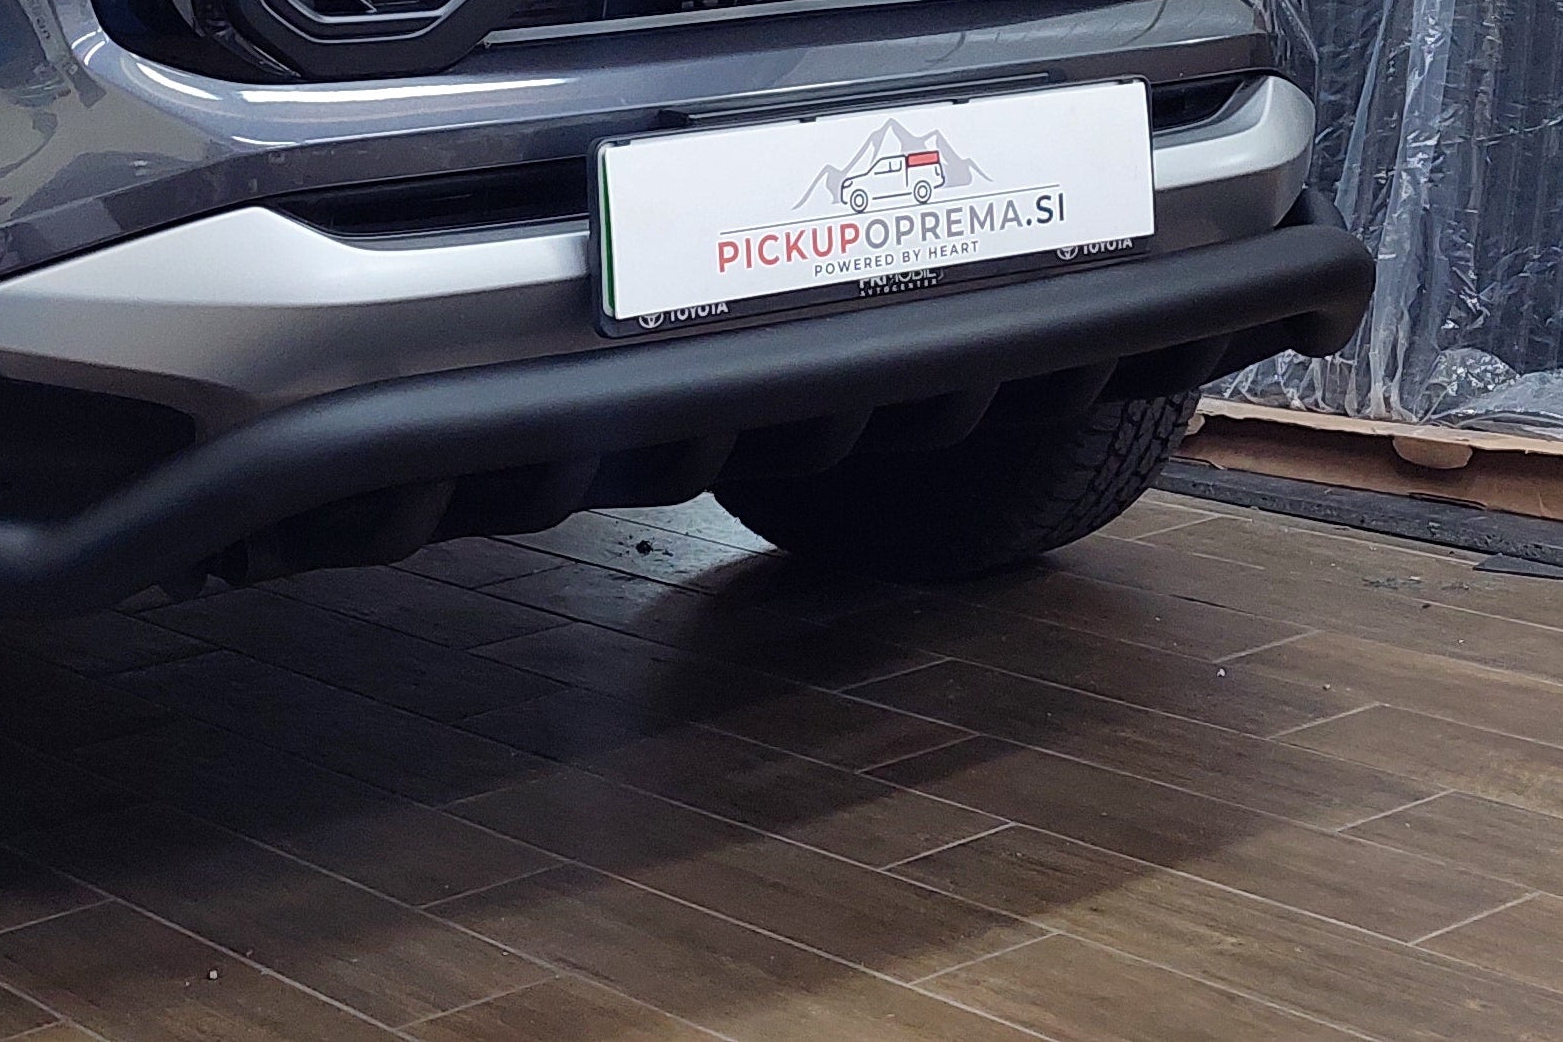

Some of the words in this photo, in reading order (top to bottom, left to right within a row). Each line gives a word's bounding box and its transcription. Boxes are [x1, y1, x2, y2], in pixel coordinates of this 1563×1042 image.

[717, 192, 1065, 273] PICKUPOPREMA.SI
[814, 253, 895, 277] POWERED
[902, 248, 921, 264] BY
[928, 240, 979, 259] HEART
[669, 302, 729, 322] TOYOTA
